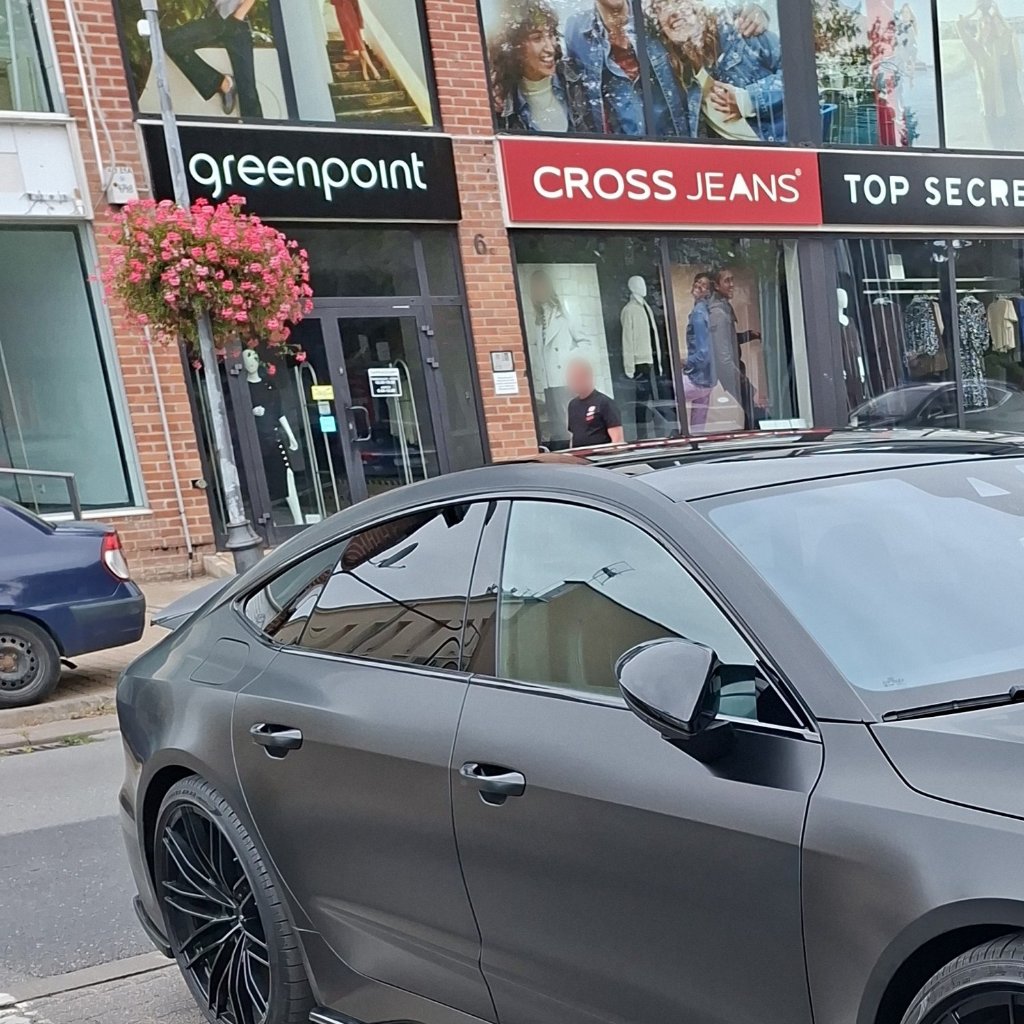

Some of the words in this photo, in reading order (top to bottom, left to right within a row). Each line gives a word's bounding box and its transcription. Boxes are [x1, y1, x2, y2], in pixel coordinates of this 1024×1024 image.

[188, 152, 427, 201] greenpoint
[532, 165, 677, 202] CROSS
[686, 171, 801, 203] JEANS
[843, 174, 909, 205] TOP
